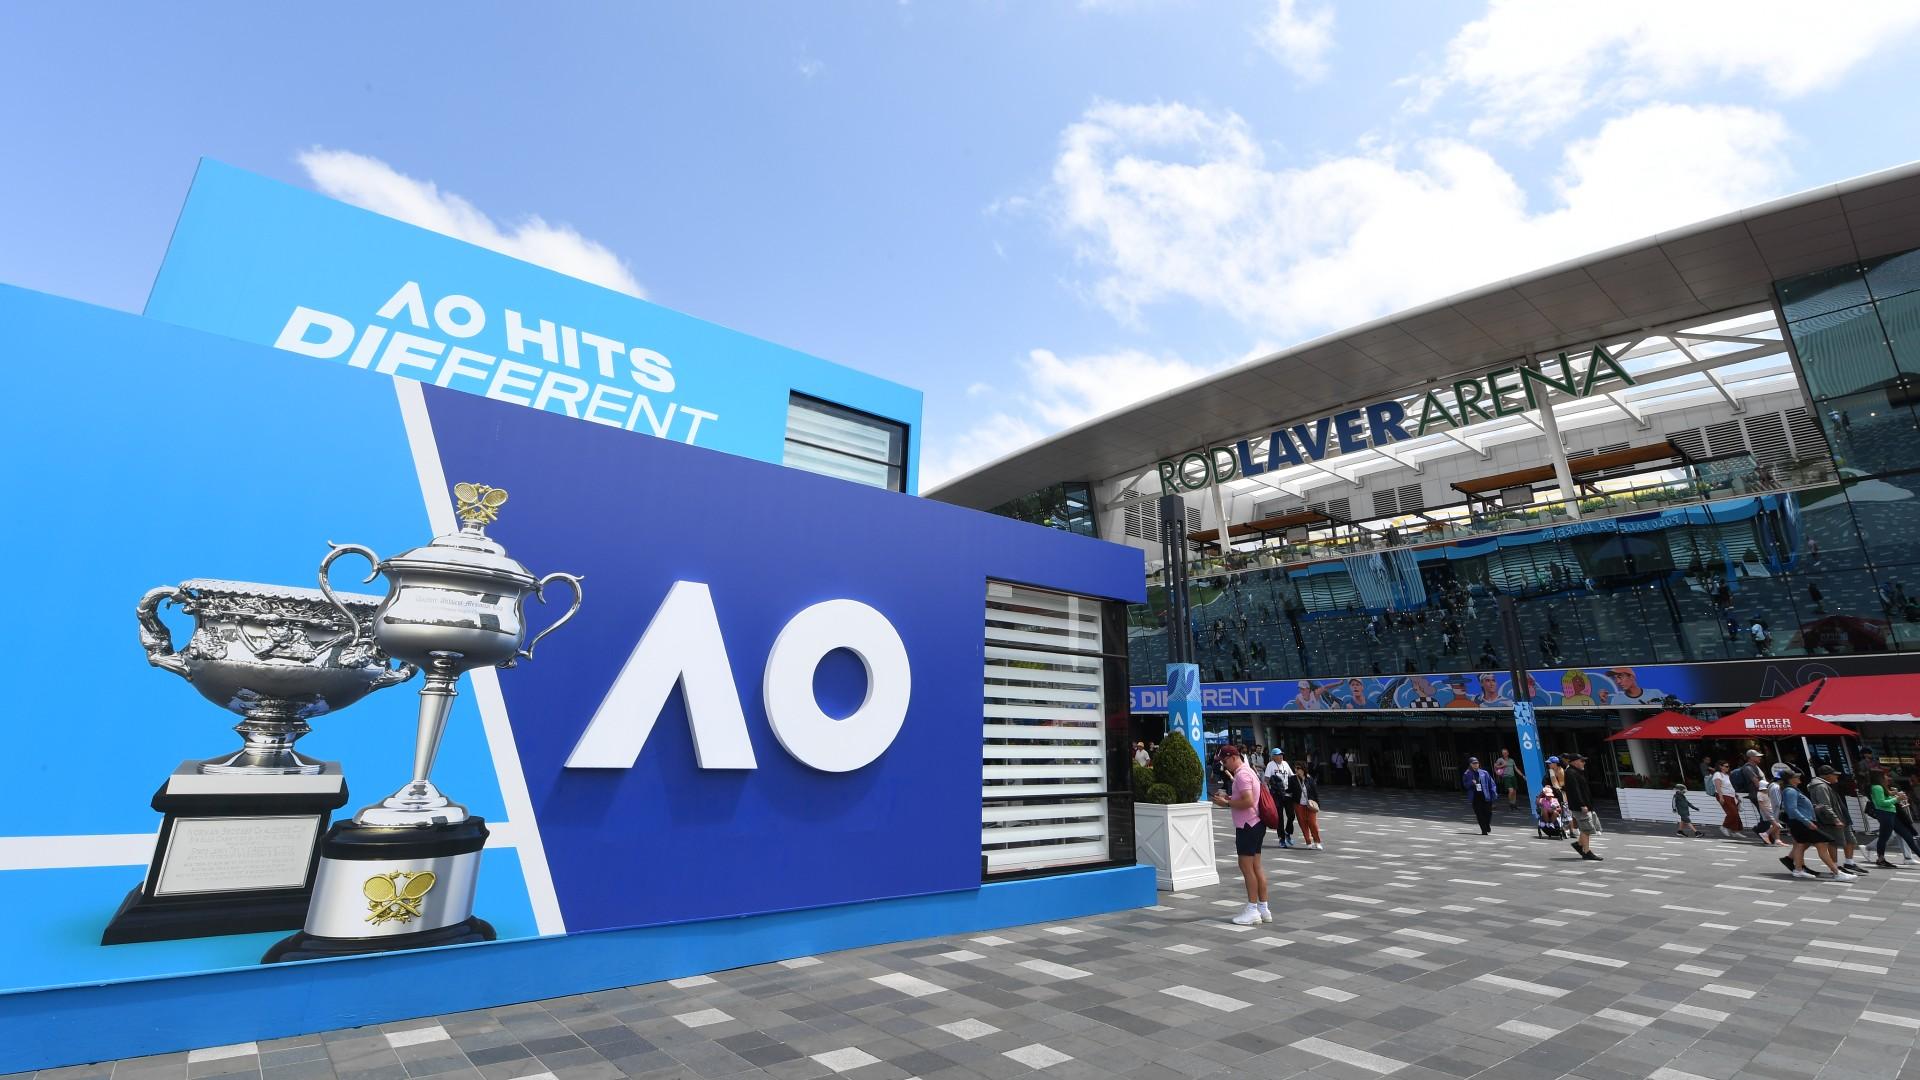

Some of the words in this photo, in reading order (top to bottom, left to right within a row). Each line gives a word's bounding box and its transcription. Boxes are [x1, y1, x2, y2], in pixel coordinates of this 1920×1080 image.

[273, 305, 720, 445] DIFFERENT
[375, 280, 486, 339] AO
[504, 308, 677, 393] HITS
[564, 580, 912, 773] AO
